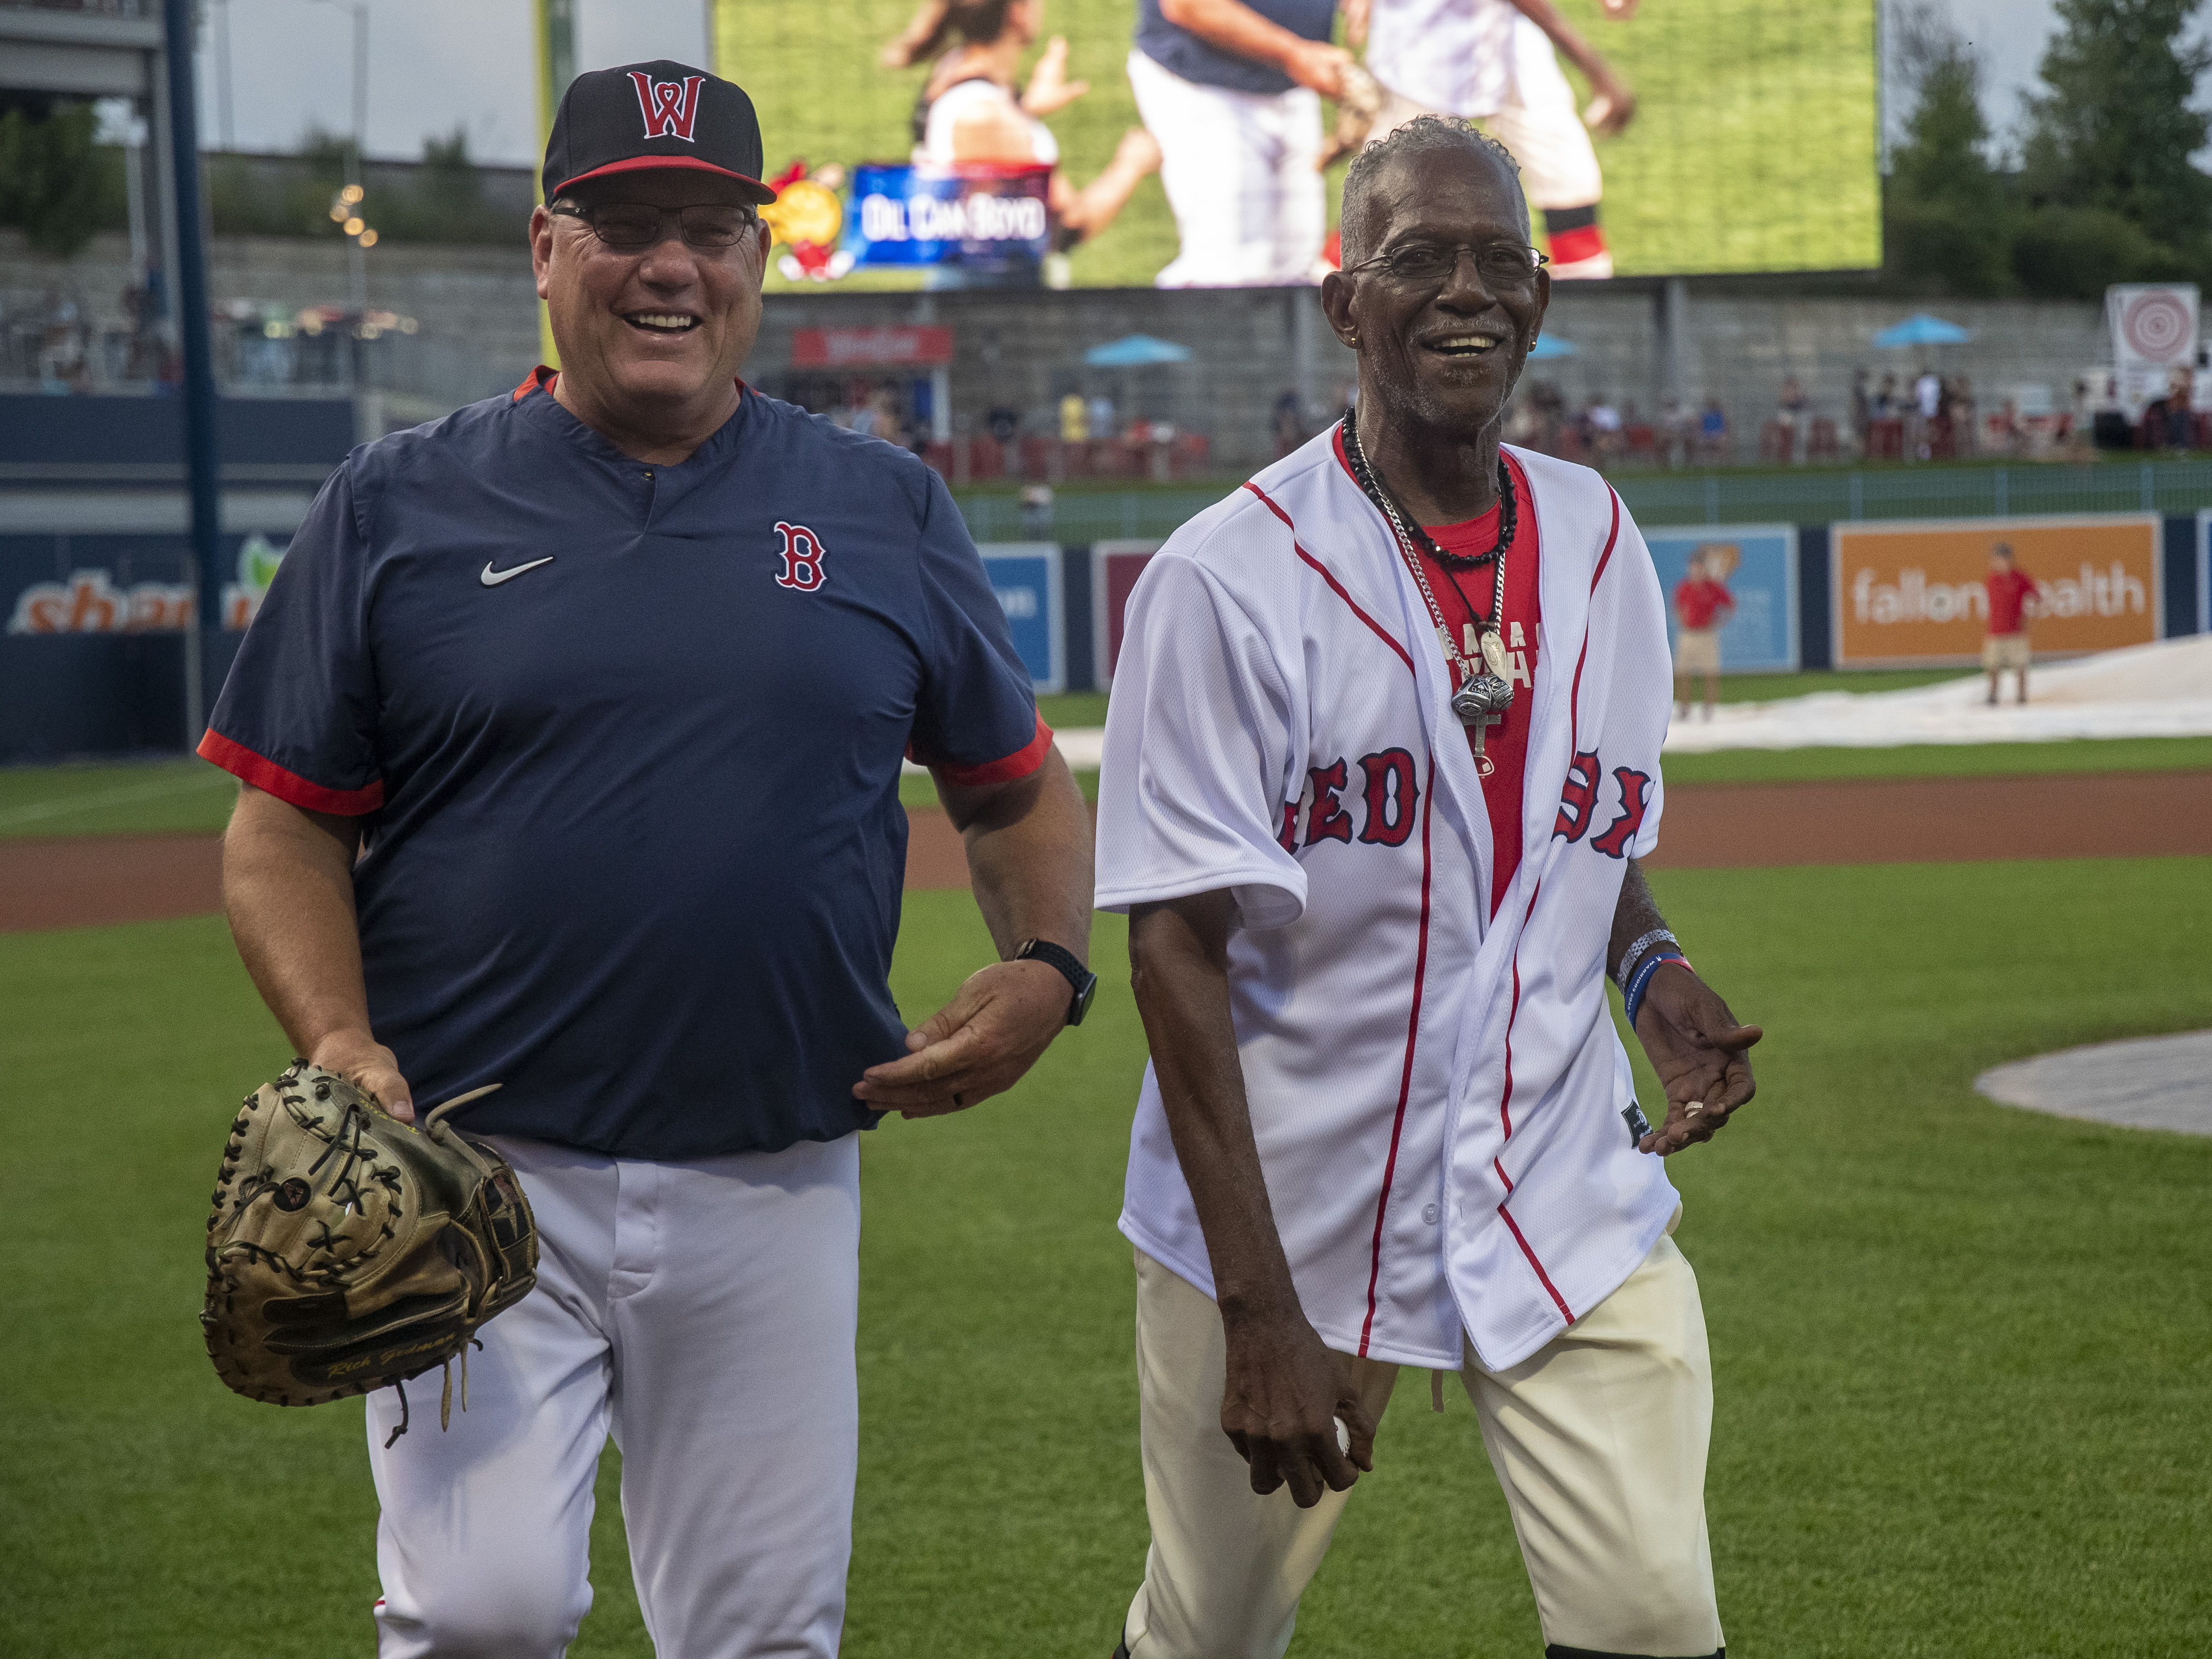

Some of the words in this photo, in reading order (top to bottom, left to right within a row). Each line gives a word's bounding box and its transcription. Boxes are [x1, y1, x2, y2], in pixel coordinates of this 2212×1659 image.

[627, 72, 706, 142] W
[774, 521, 827, 592] B
[2022, 561, 2146, 619] ealth
[1632, 960, 1655, 992] WARRIORS
